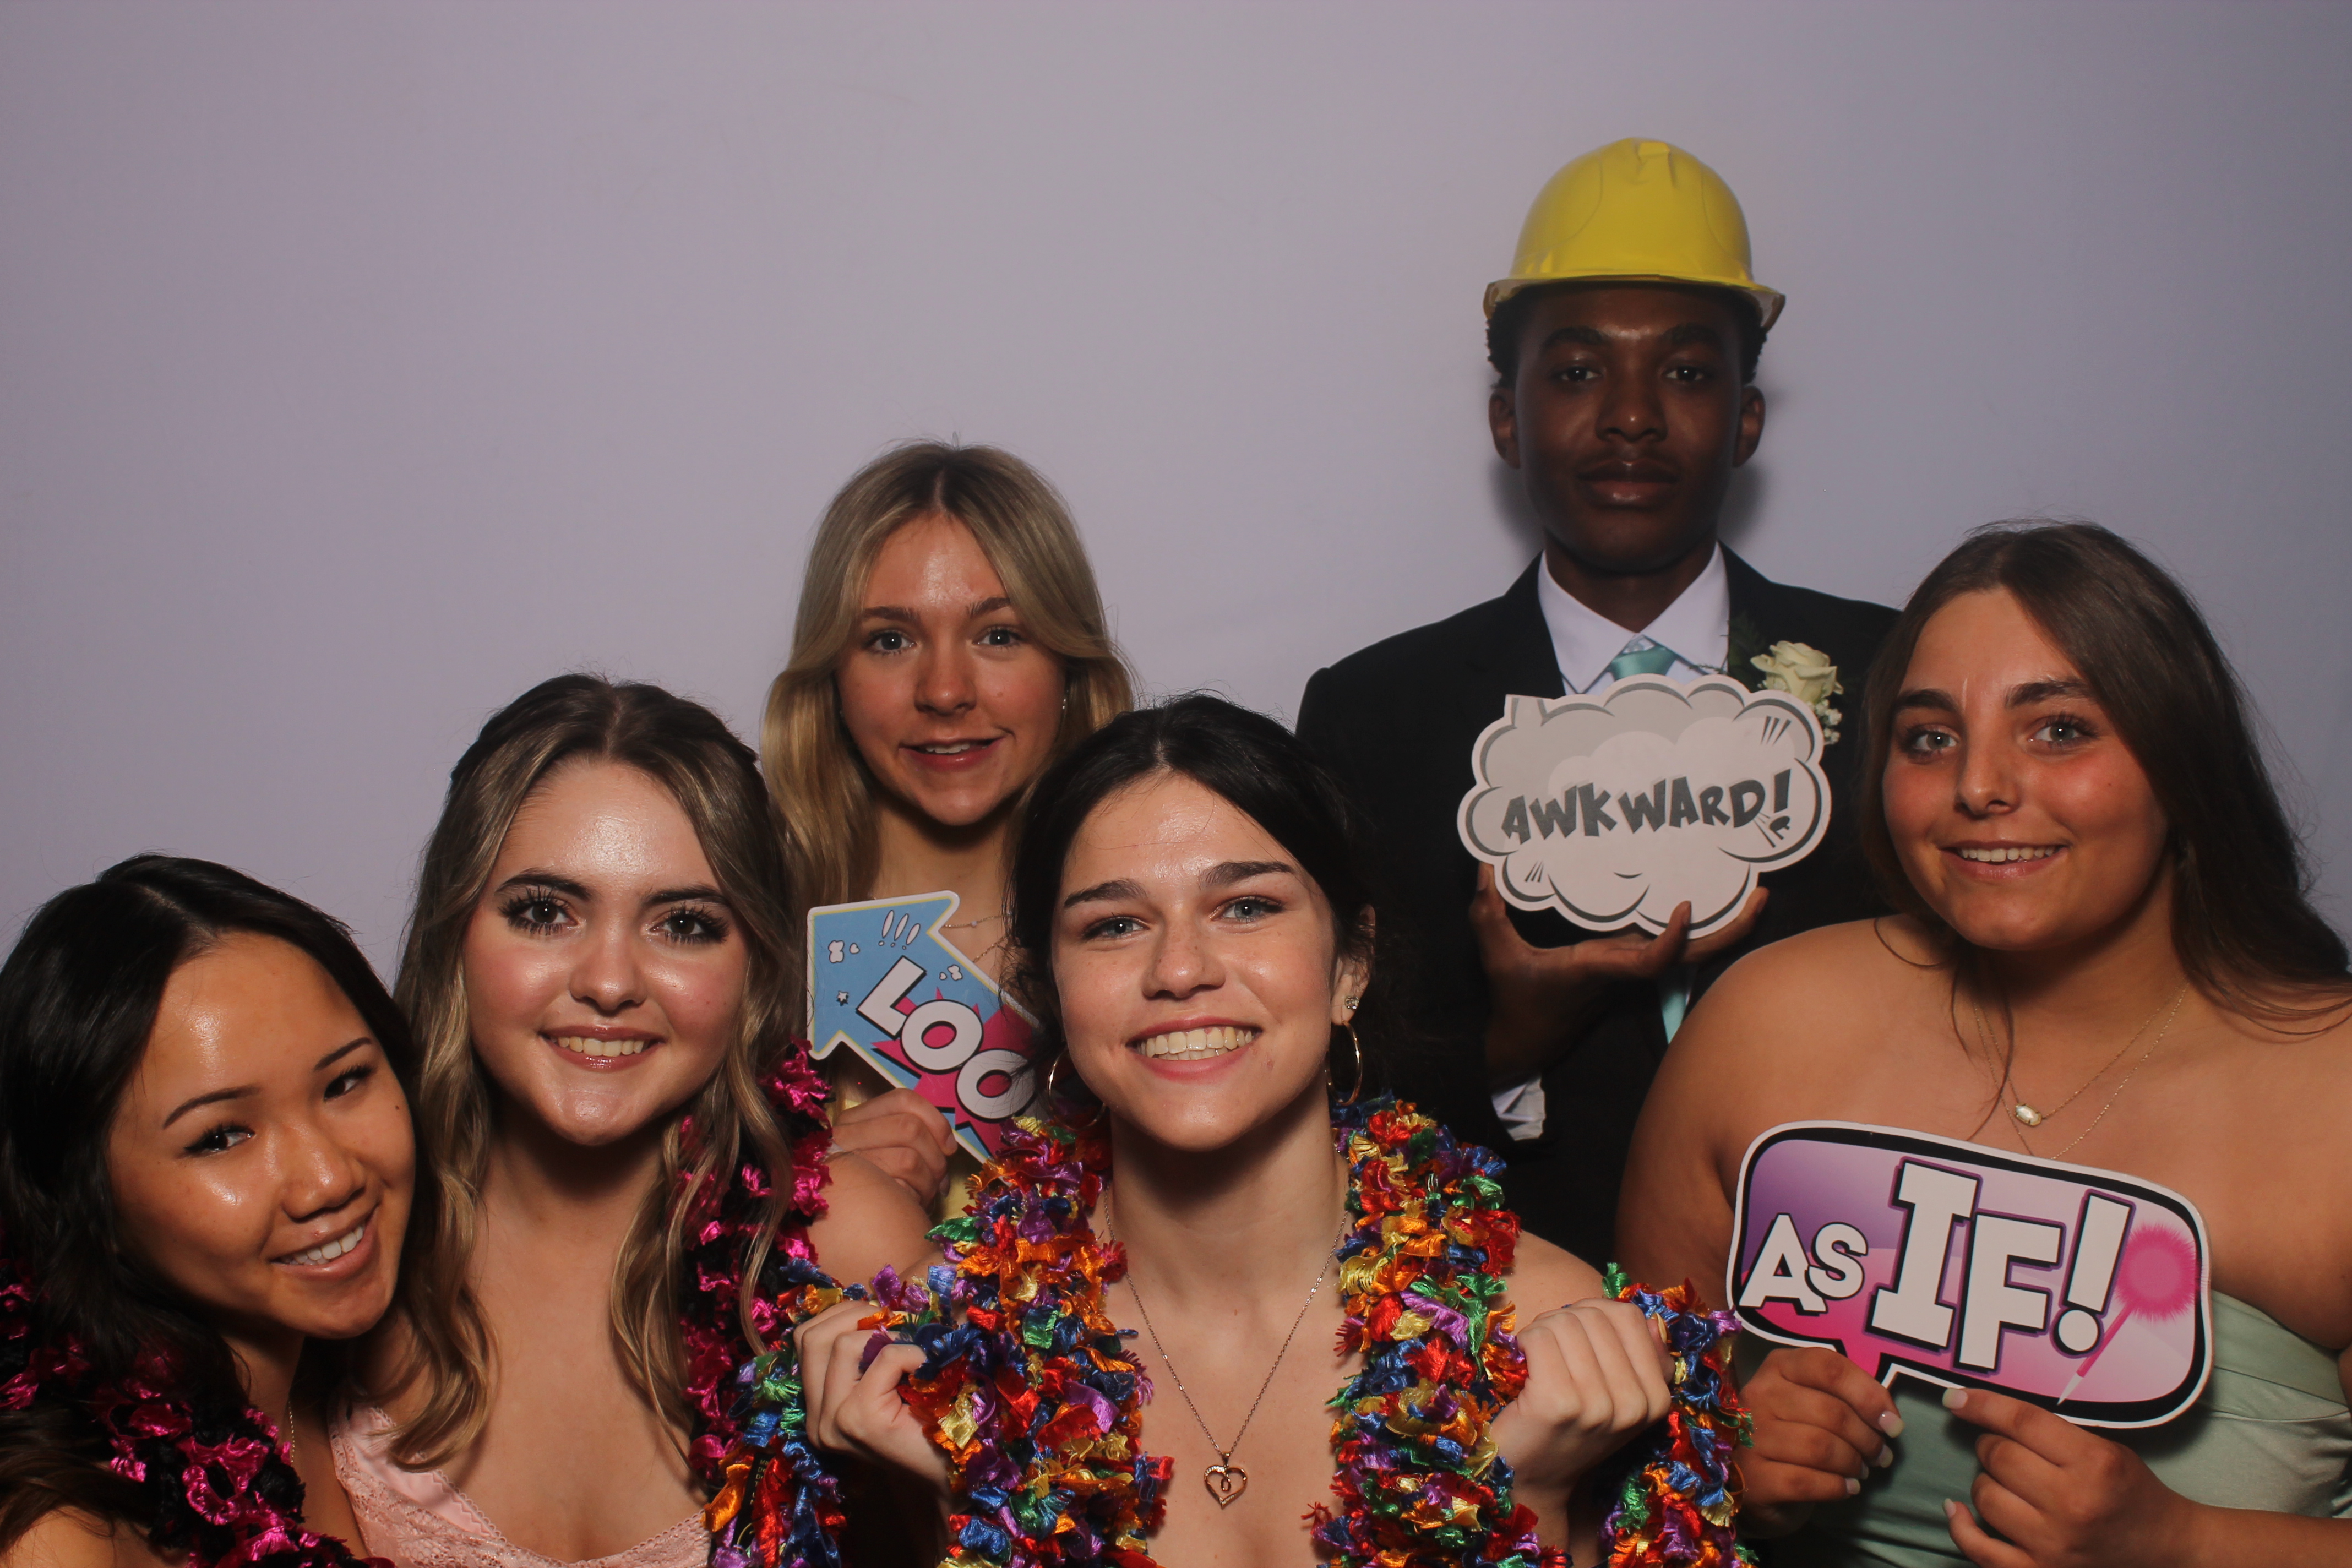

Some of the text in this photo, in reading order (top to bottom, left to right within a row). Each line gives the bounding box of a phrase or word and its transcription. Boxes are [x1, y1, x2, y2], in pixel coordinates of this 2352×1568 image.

[1501, 768, 1792, 845] AWKWARD!
[856, 955, 1042, 1123] LOO
[1739, 1158, 2133, 1373] AS IF!
